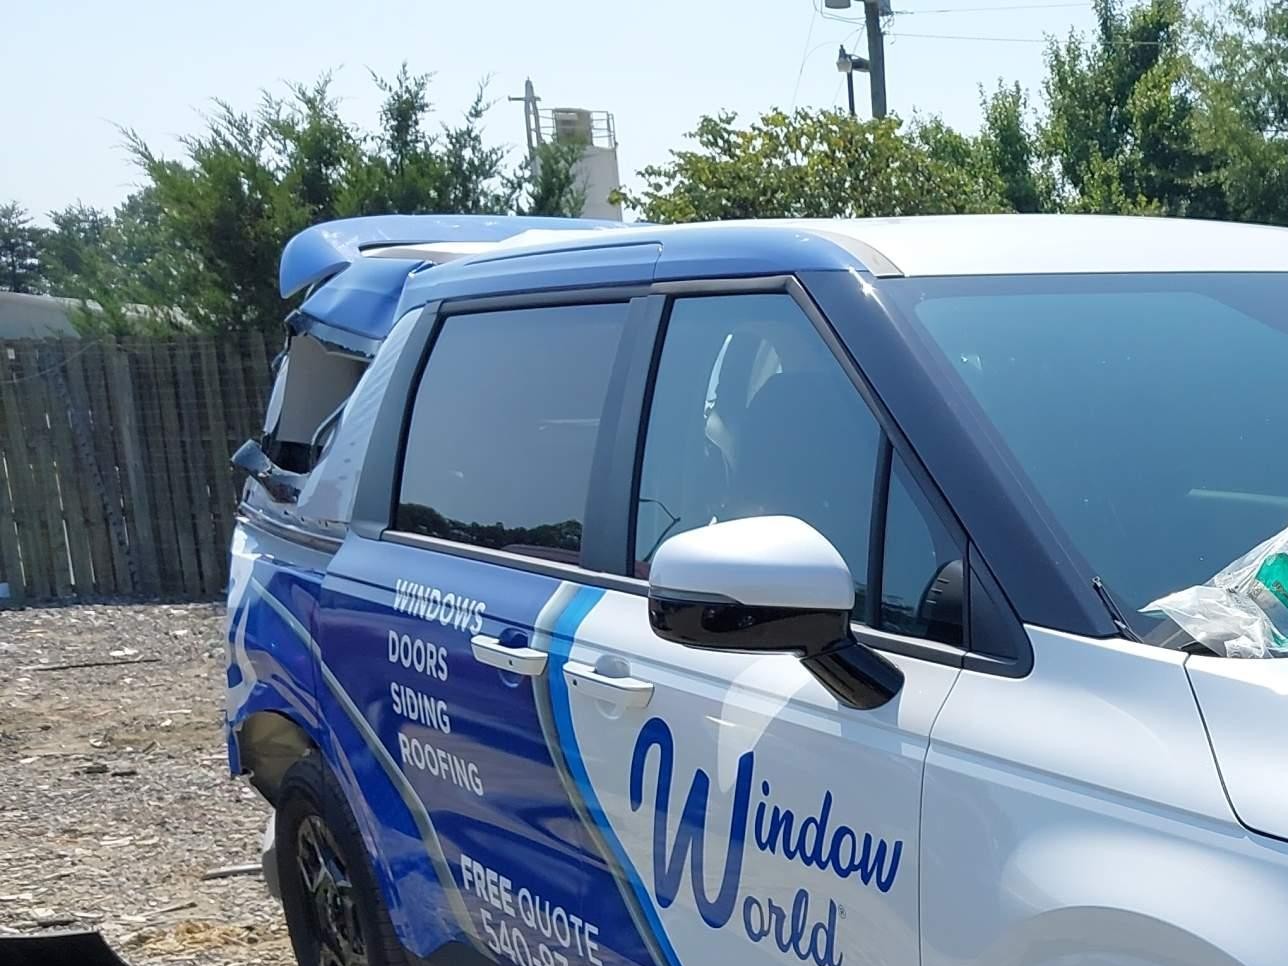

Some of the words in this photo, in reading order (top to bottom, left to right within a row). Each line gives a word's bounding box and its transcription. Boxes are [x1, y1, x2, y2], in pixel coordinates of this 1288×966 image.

[393, 579, 486, 635] WINDOWS
[388, 630, 448, 682] DOORS
[392, 683, 450, 734] SIDING
[399, 732, 484, 796] ROOFING
[630, 717, 903, 929] Window
[460, 854, 513, 916] FREE
